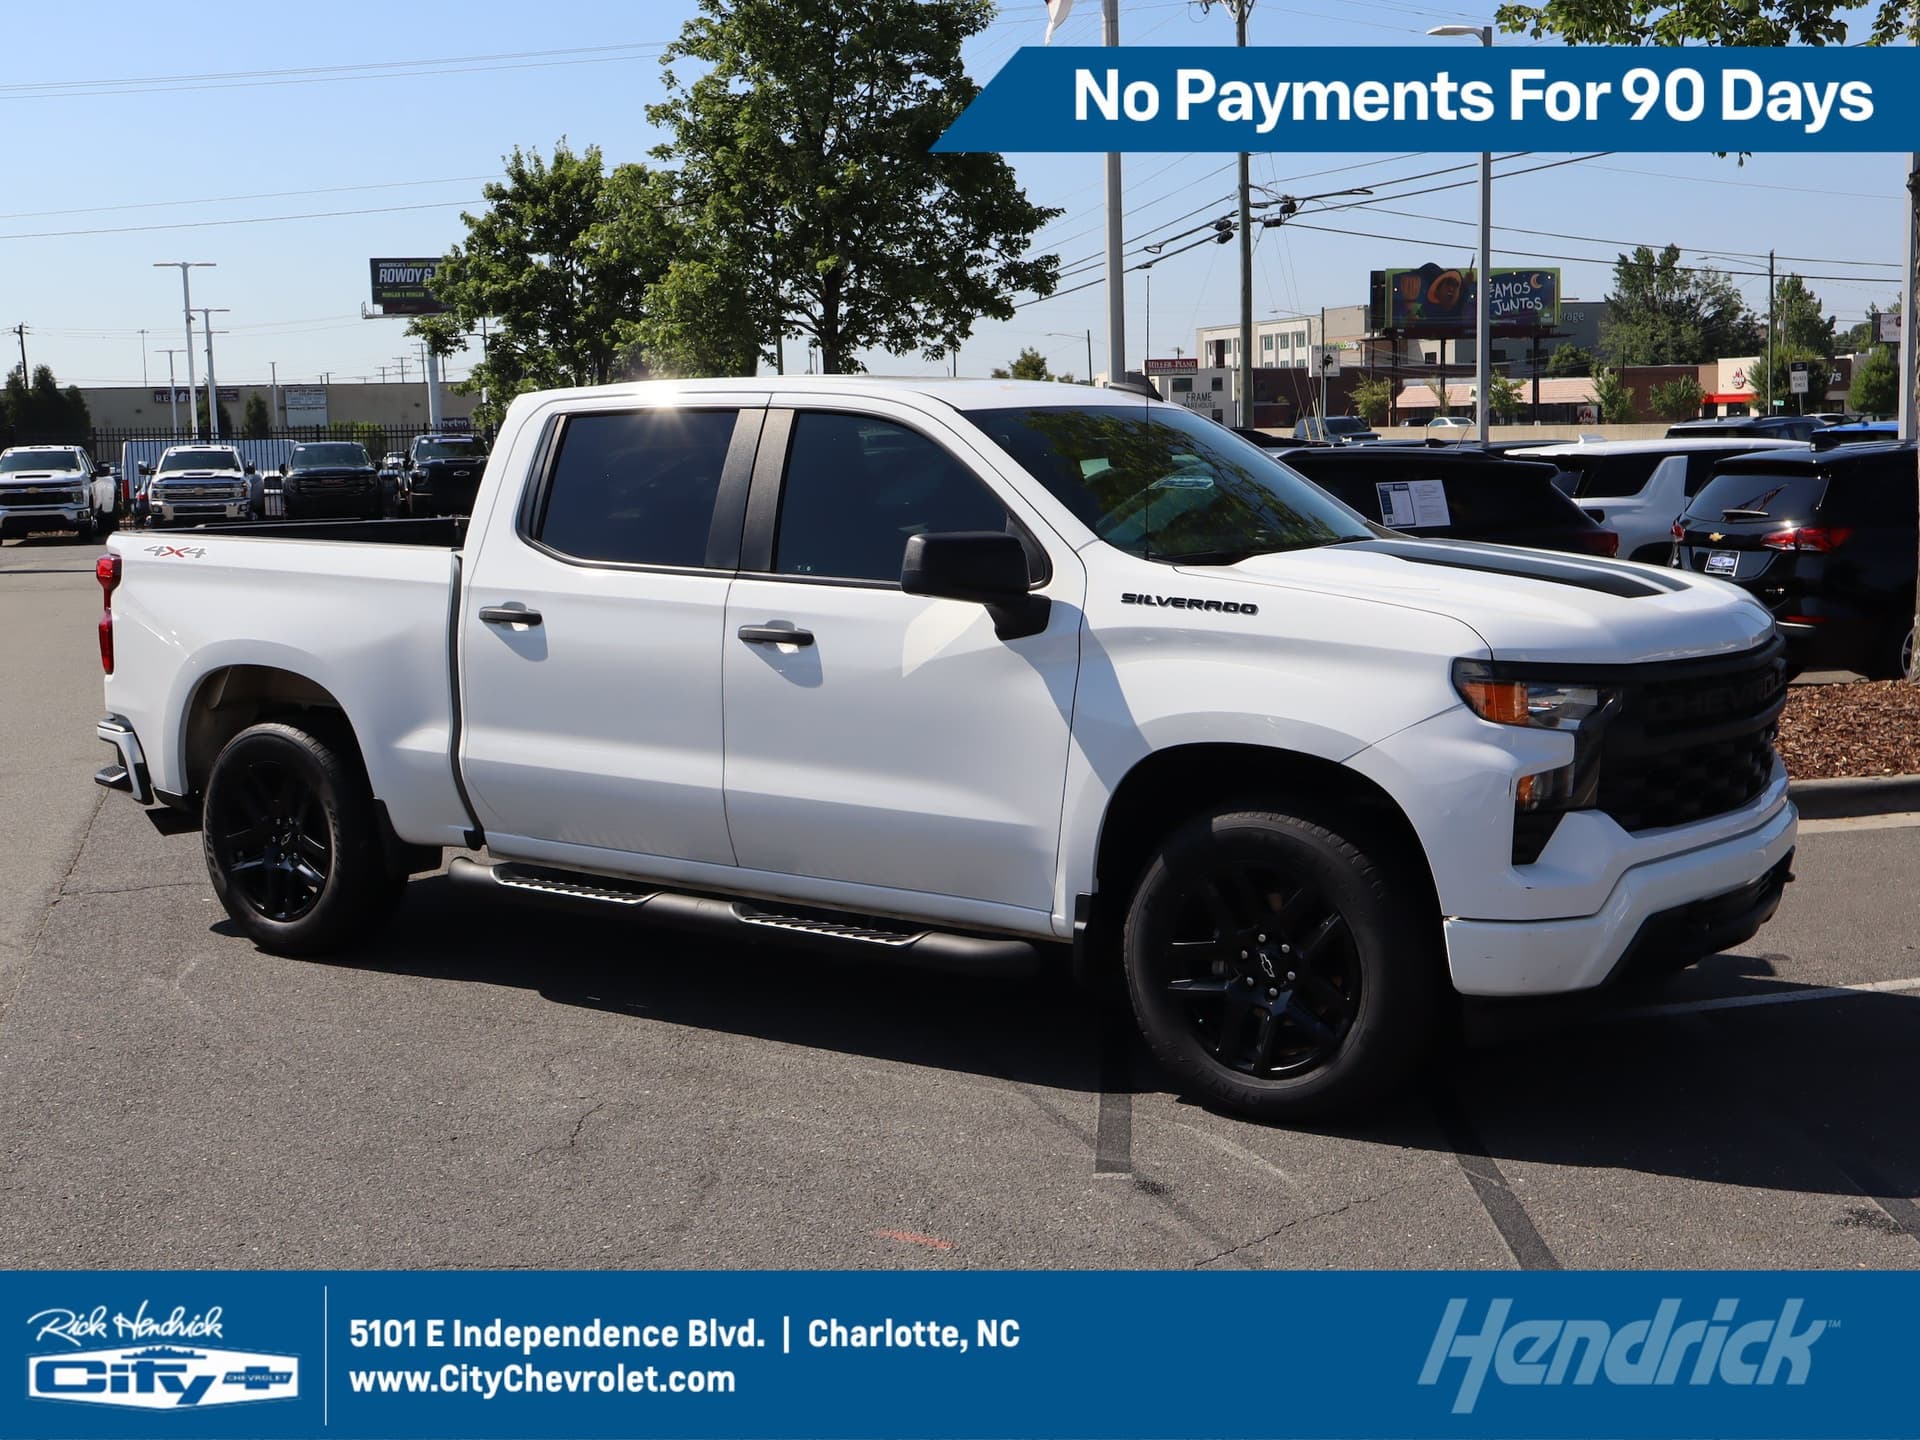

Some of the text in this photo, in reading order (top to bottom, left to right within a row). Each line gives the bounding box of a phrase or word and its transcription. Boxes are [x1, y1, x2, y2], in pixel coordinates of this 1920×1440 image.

[379, 268, 422, 282] ROWDY
[1186, 392, 1212, 401] FRAME
[1121, 593, 1259, 616] SILVERADO
